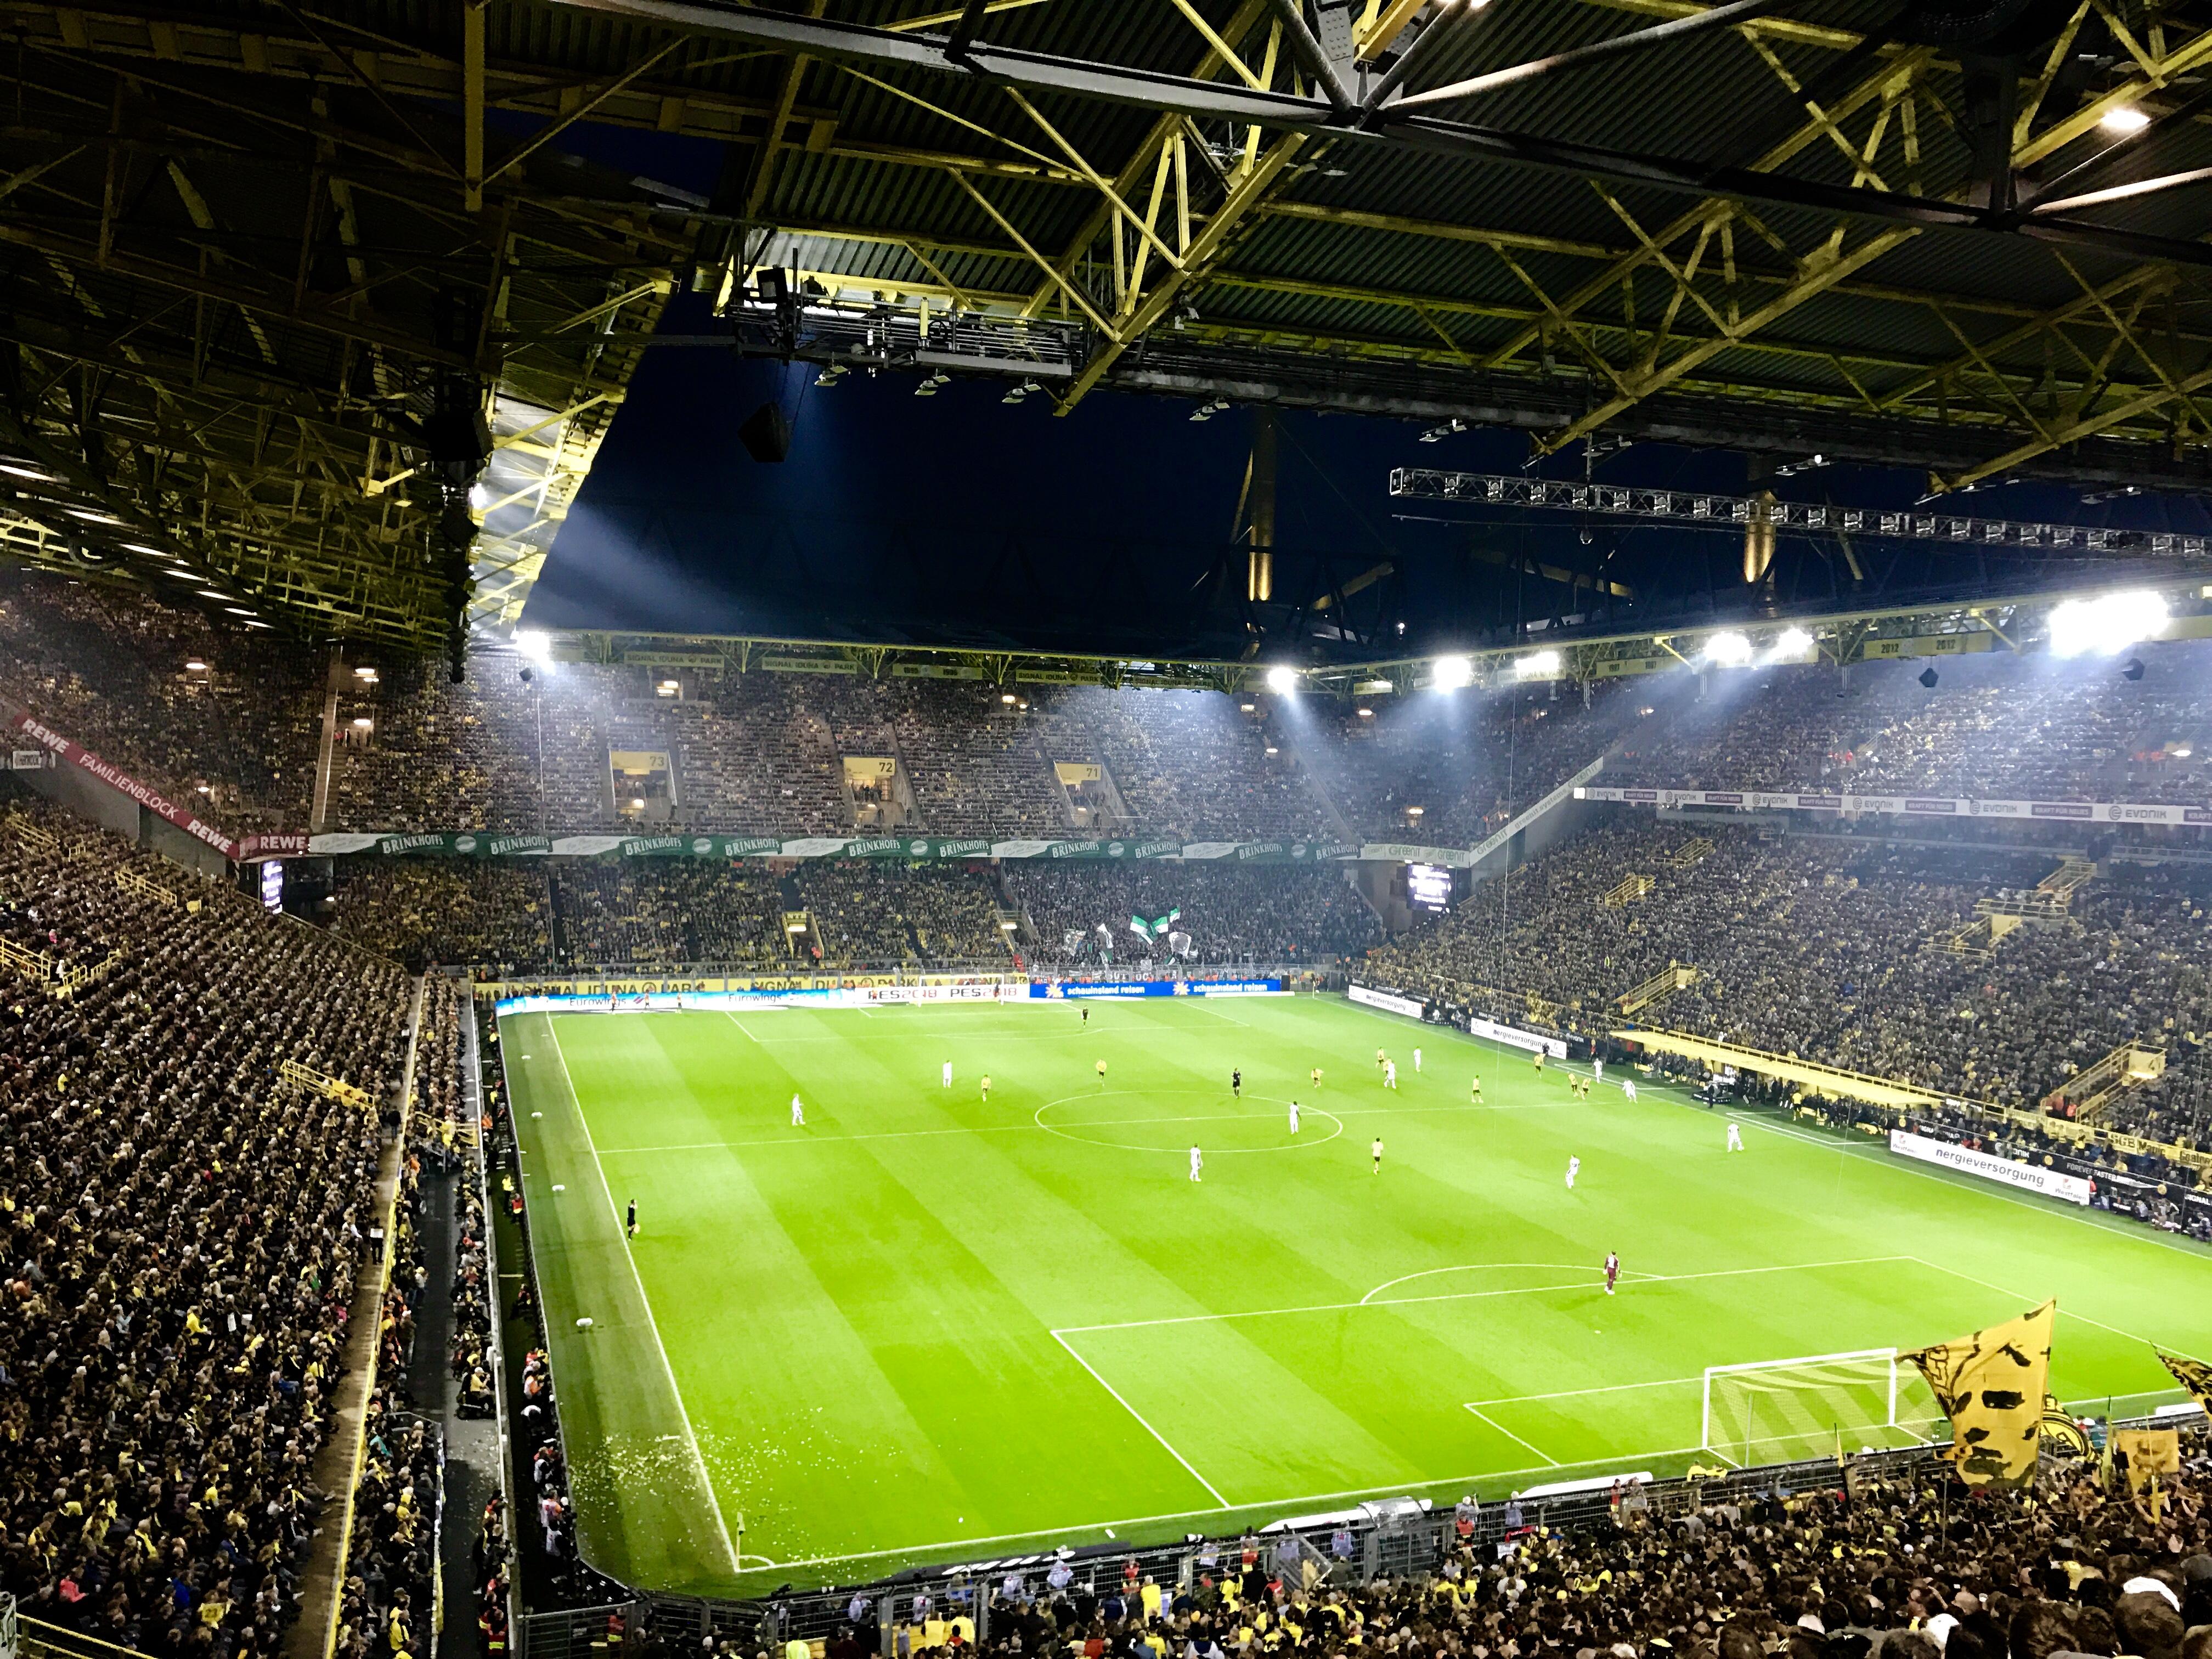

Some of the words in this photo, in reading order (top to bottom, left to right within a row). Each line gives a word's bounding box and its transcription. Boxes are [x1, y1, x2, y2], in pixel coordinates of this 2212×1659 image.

[1881, 644, 1898, 653] 2012
[650, 756, 664, 767] 73
[879, 763, 893, 772] 72
[1086, 768, 1098, 777] 71
[22, 719, 70, 754] REWE
[79, 754, 179, 819] FAMILIENBLOCK
[187, 819, 233, 853] REWE
[1763, 796, 1787, 804] EVONIK
[1865, 800, 1893, 808] EVONIK
[1983, 804, 2017, 813] EVONIK
[2125, 809, 2166, 819] EVONIK
[261, 836, 306, 849] REWE
[661, 984, 698, 994] PAR
[1068, 986, 1119, 995] schauinsland
[1194, 984, 1242, 992] schauinsland
[1936, 1148, 2045, 1187] nergieversorgung
[2093, 1169, 2117, 1180] FASTER
[2055, 1187, 2086, 1200] Westfalen
